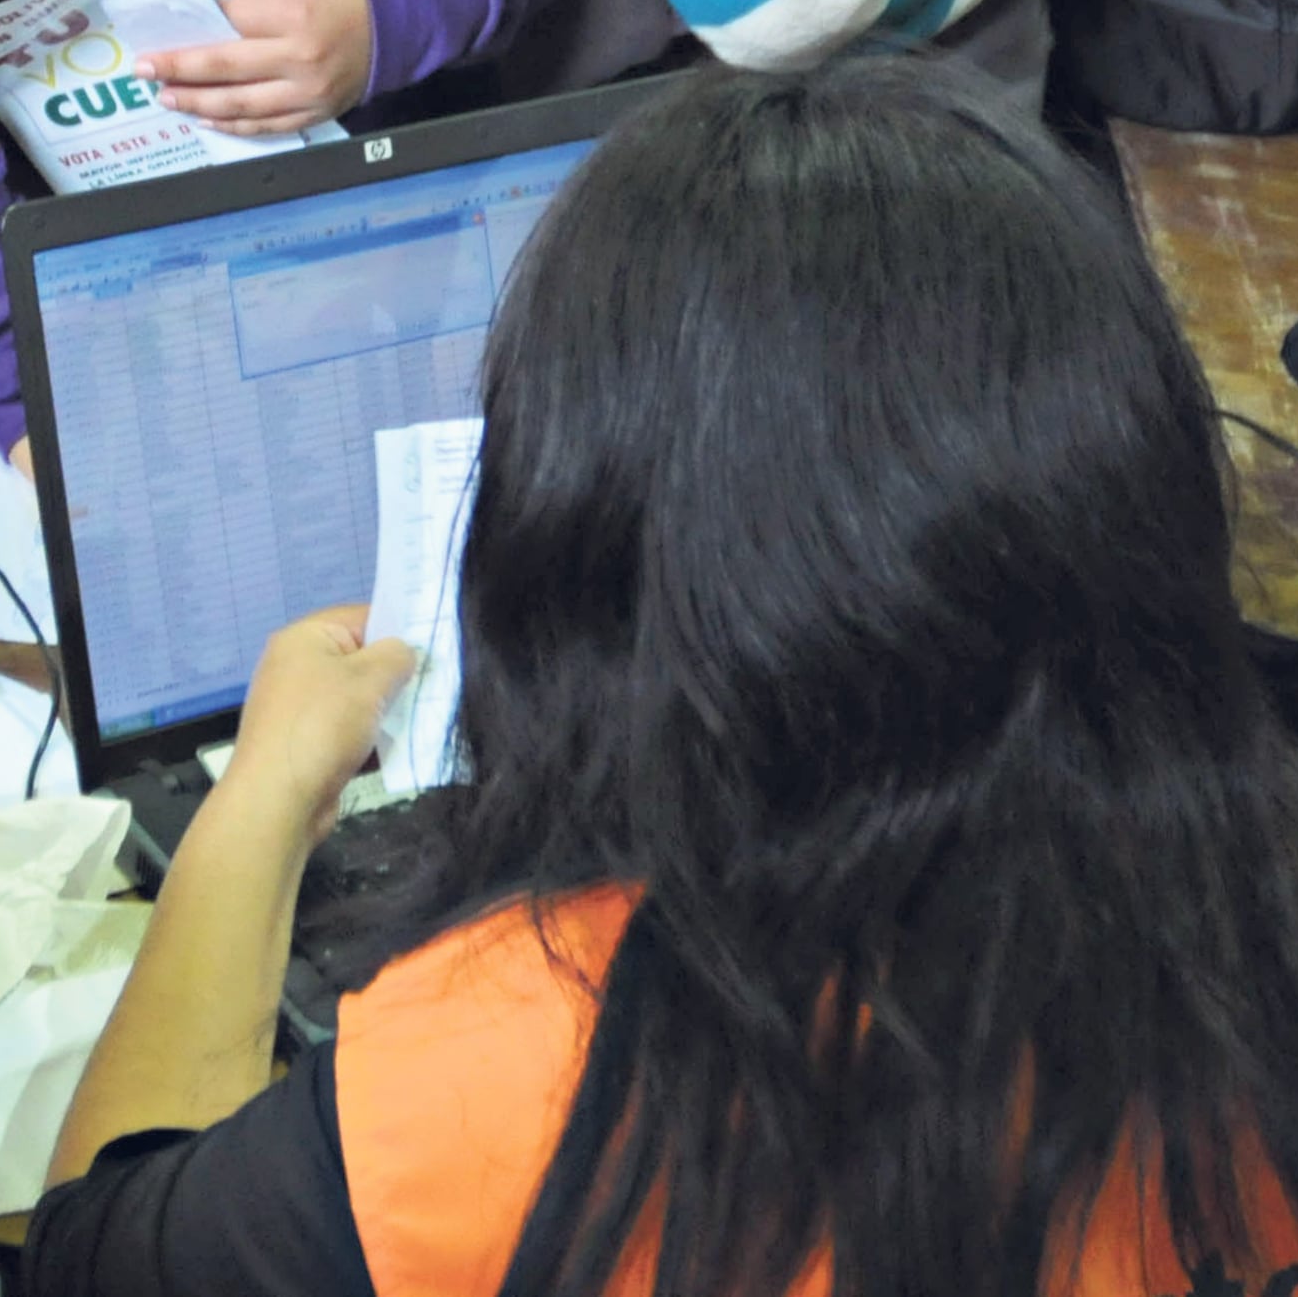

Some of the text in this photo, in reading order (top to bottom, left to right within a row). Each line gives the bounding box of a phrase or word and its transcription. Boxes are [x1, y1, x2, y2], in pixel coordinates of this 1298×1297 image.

[21, 23, 123, 89] VO
[58, 148, 104, 168] VOTA
[110, 134, 151, 154] ESTE
